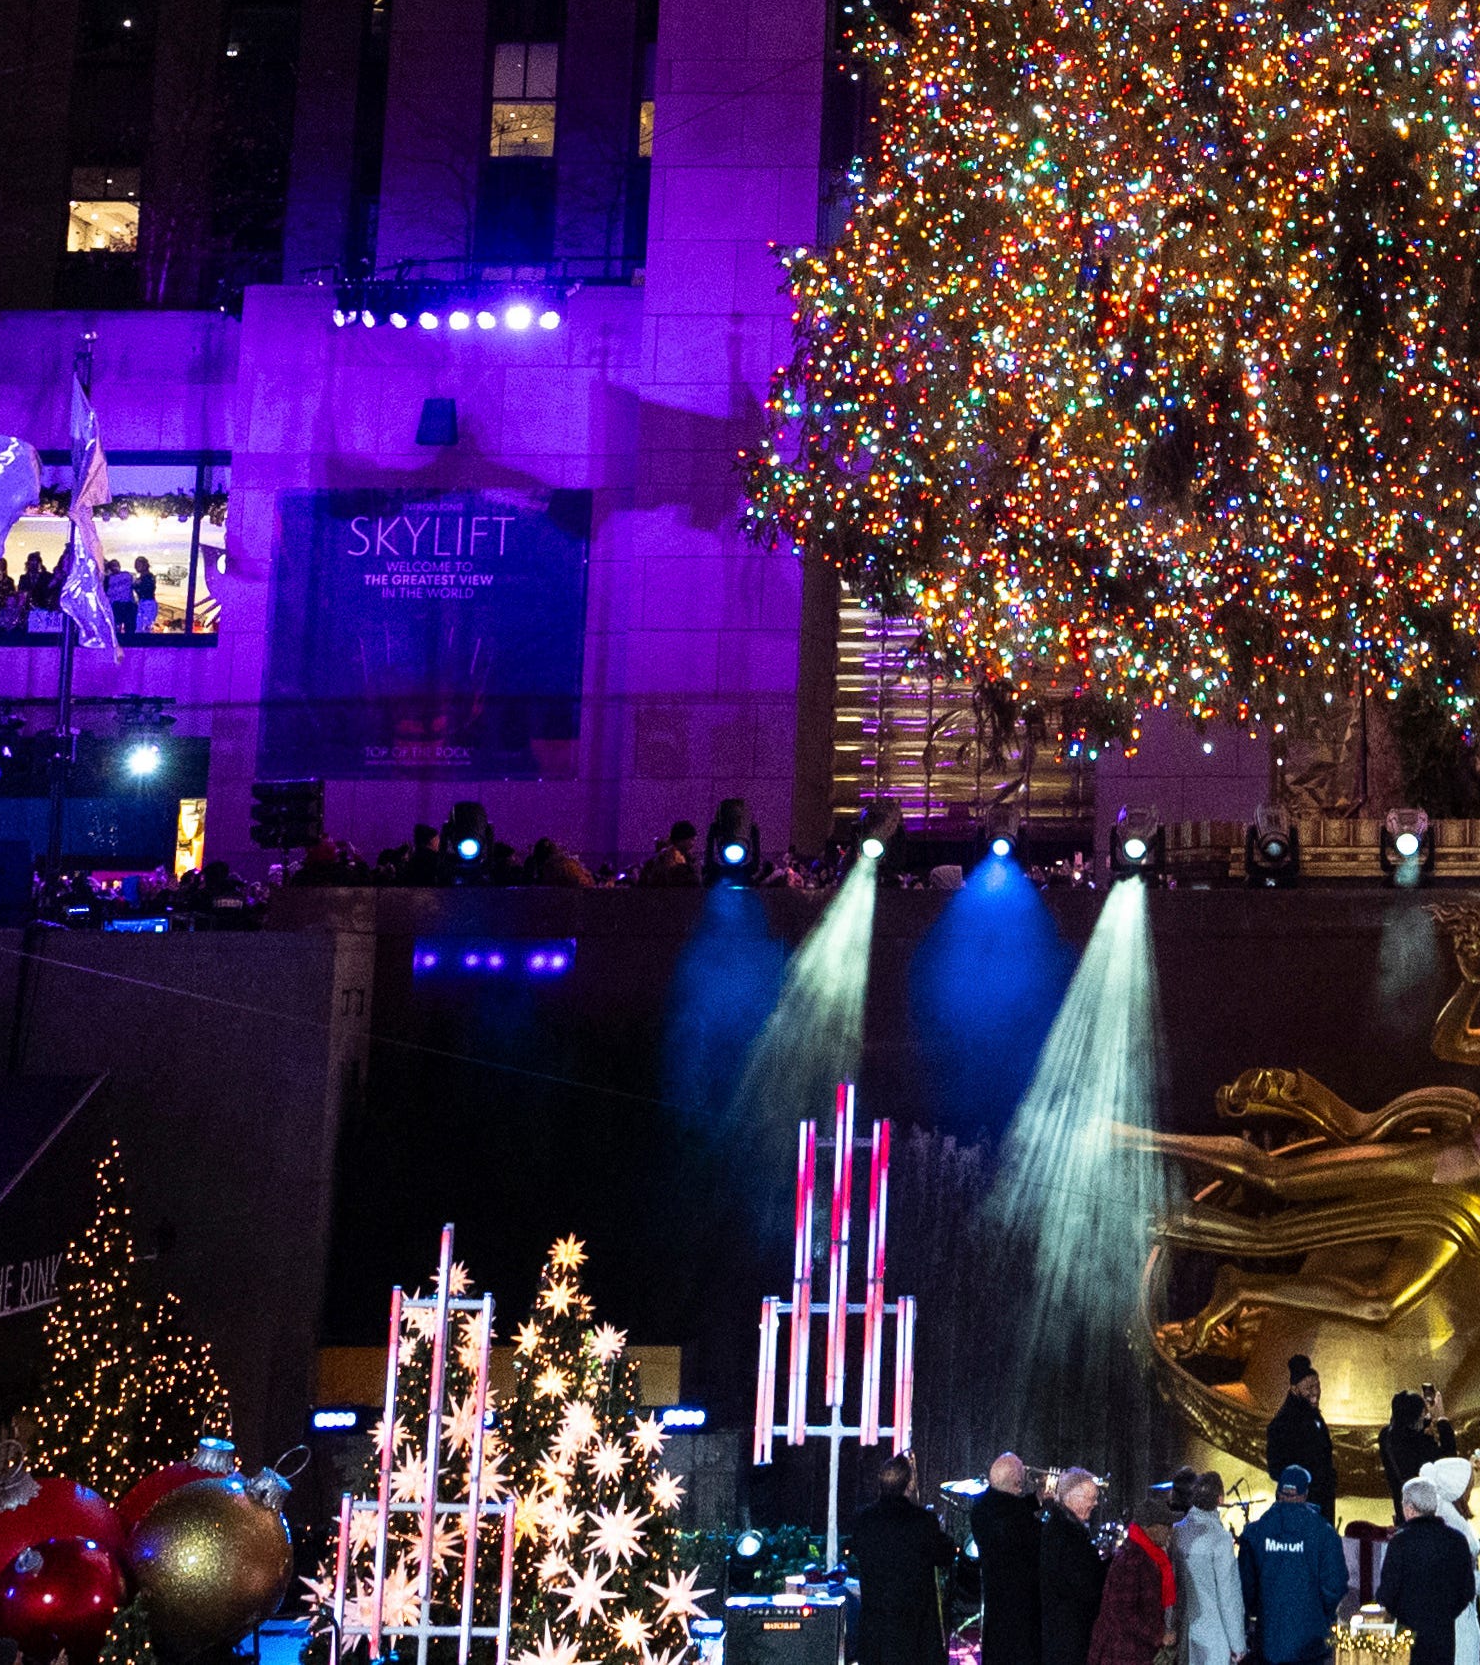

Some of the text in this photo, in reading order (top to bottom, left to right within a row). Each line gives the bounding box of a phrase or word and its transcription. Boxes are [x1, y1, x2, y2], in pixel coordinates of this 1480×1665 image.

[347, 516, 516, 556] SKYLIFT
[386, 561, 473, 573] WELCOME TO
[364, 574, 494, 586] THE GREATEST VIEW
[381, 587, 475, 599] IN THE WORLD
[18, 1251, 65, 1310] RINK
